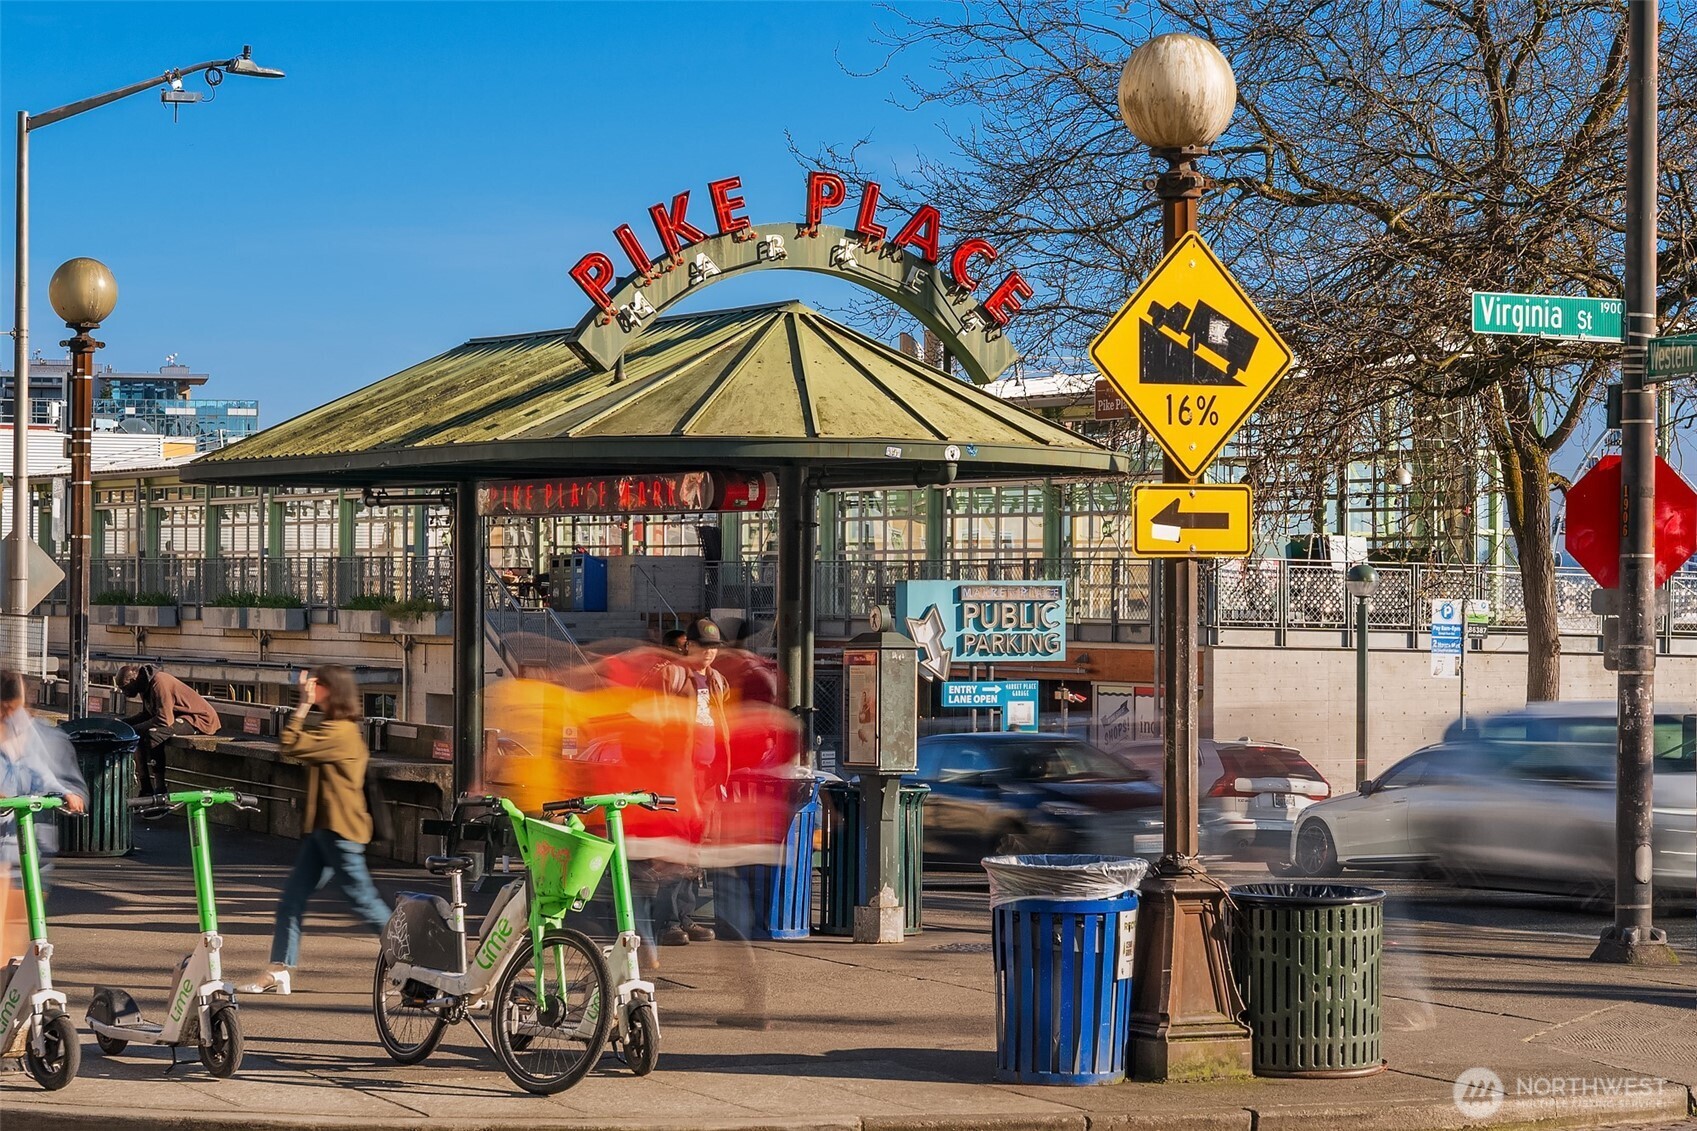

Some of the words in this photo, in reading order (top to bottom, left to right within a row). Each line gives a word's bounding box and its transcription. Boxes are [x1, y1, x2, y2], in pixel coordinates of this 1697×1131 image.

[568, 176, 750, 312] PIKE
[806, 171, 1034, 326] PLACE
[1480, 296, 1563, 333] Virginia
[1577, 311, 1593, 331] St
[1600, 302, 1623, 315] 1900
[1650, 343, 1694, 371] Western
[1097, 399, 1115, 412] Pike
[1115, 398, 1129, 410] Pla
[1166, 394, 1219, 426] 16%
[963, 602, 1061, 629] PUBLIC
[964, 632, 1061, 654] PARKING
[948, 685, 978, 694] ENTRY
[948, 695, 972, 704] LANE
[973, 695, 998, 704] OPEN
[475, 916, 513, 971] Lime
[170, 978, 194, 1024] Lime
